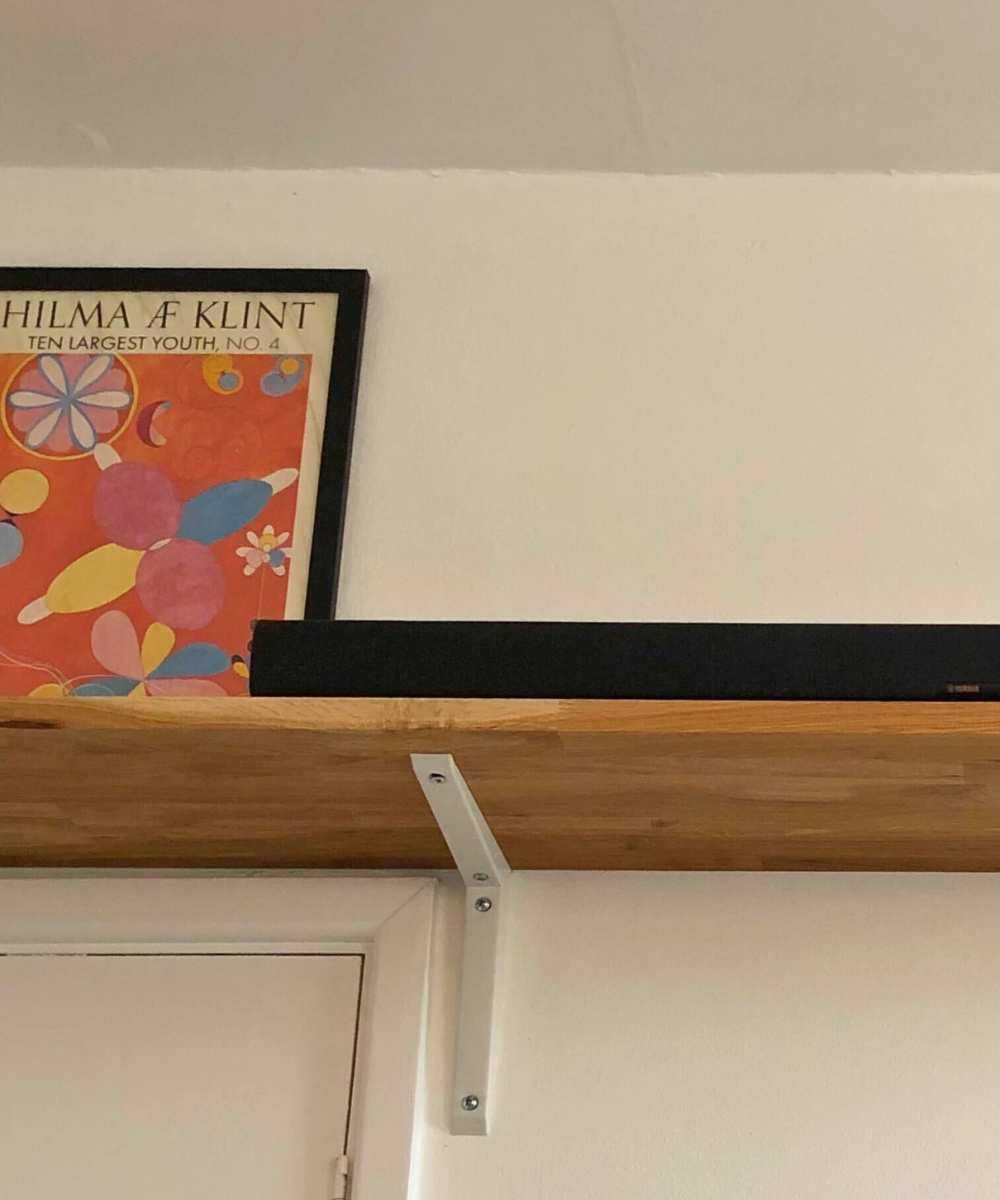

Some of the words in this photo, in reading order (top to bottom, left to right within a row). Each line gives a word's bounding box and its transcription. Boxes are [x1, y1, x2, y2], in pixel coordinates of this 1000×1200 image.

[2, 300, 130, 329] HILMA
[194, 300, 316, 329] KLINT
[28, 335, 64, 350] TEN
[69, 335, 147, 350] LARGEST
[152, 336, 220, 352] YOUTH,
[268, 337, 280, 350] 4
